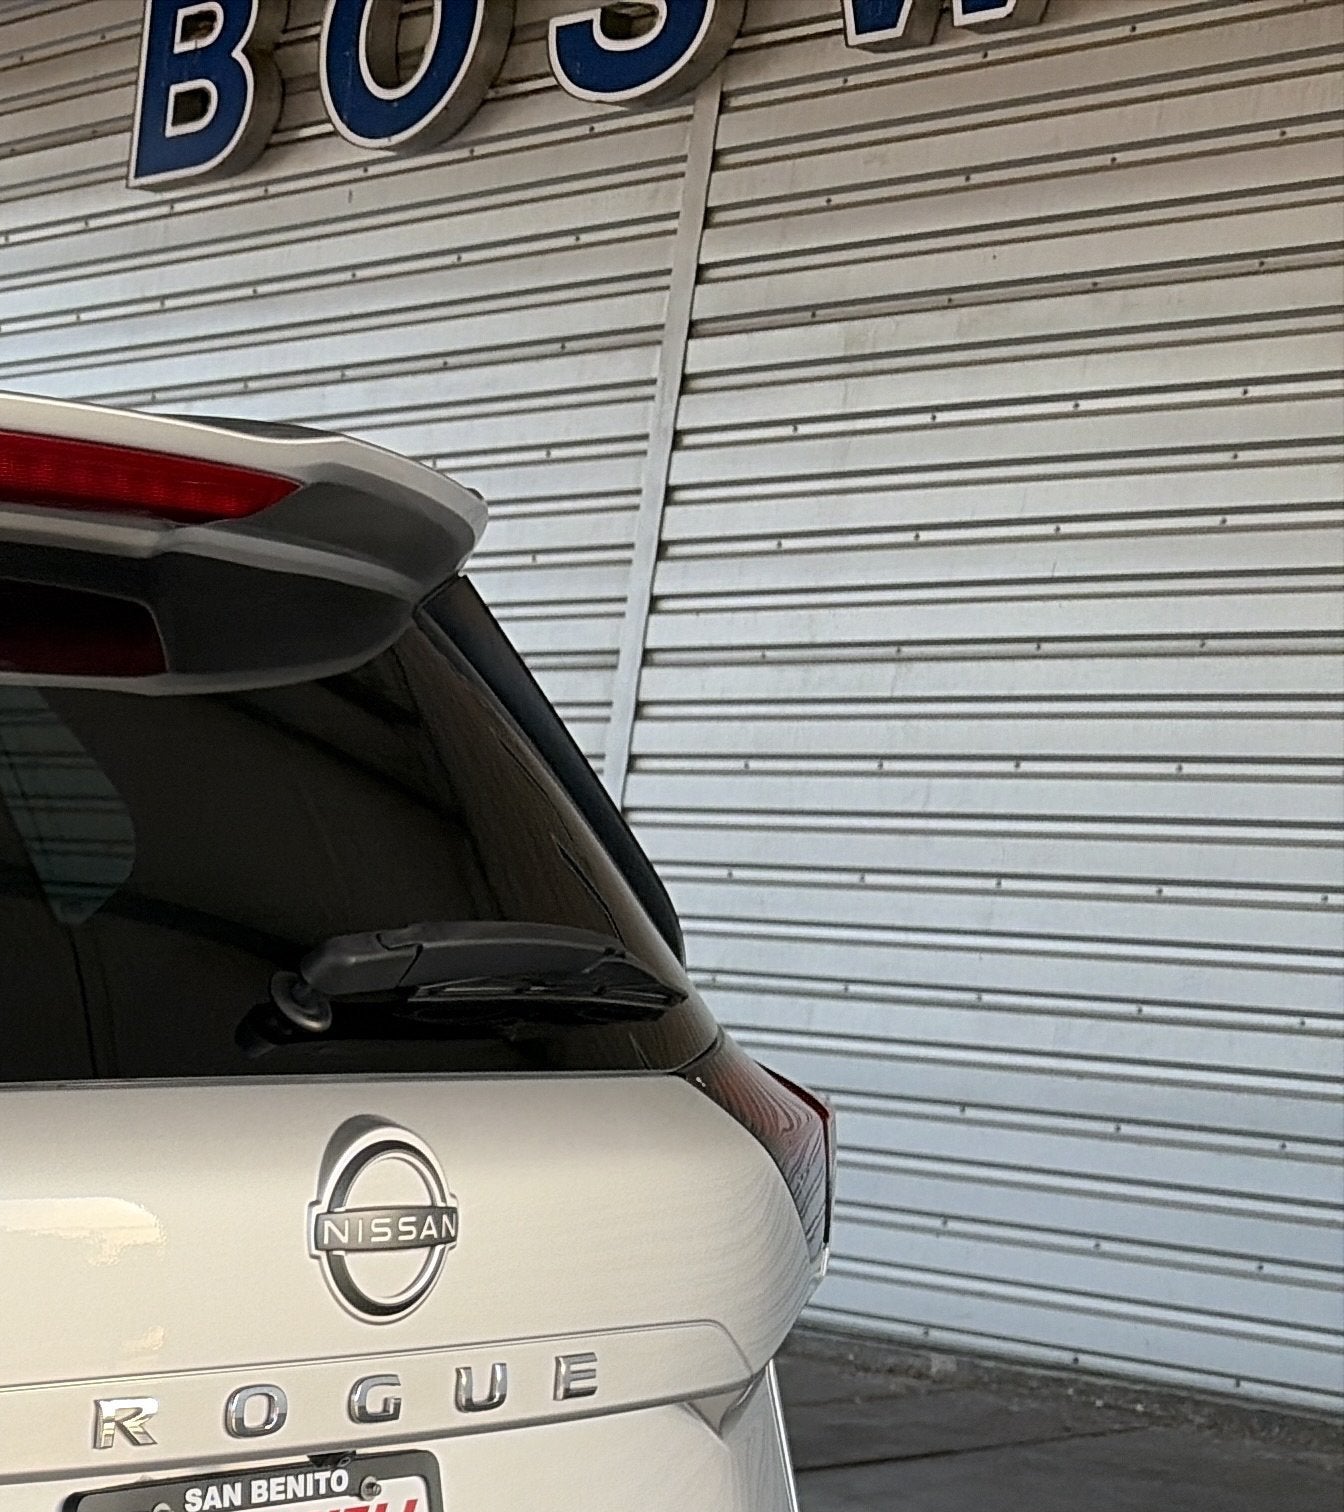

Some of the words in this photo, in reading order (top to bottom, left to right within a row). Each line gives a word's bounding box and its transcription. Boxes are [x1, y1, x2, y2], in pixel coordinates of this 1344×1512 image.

[126, 0, 1015, 188] BOS
[323, 1210, 458, 1247] NISSAN
[92, 1351, 600, 1450] ROGUE
[250, 1468, 350, 1504] BENITO
